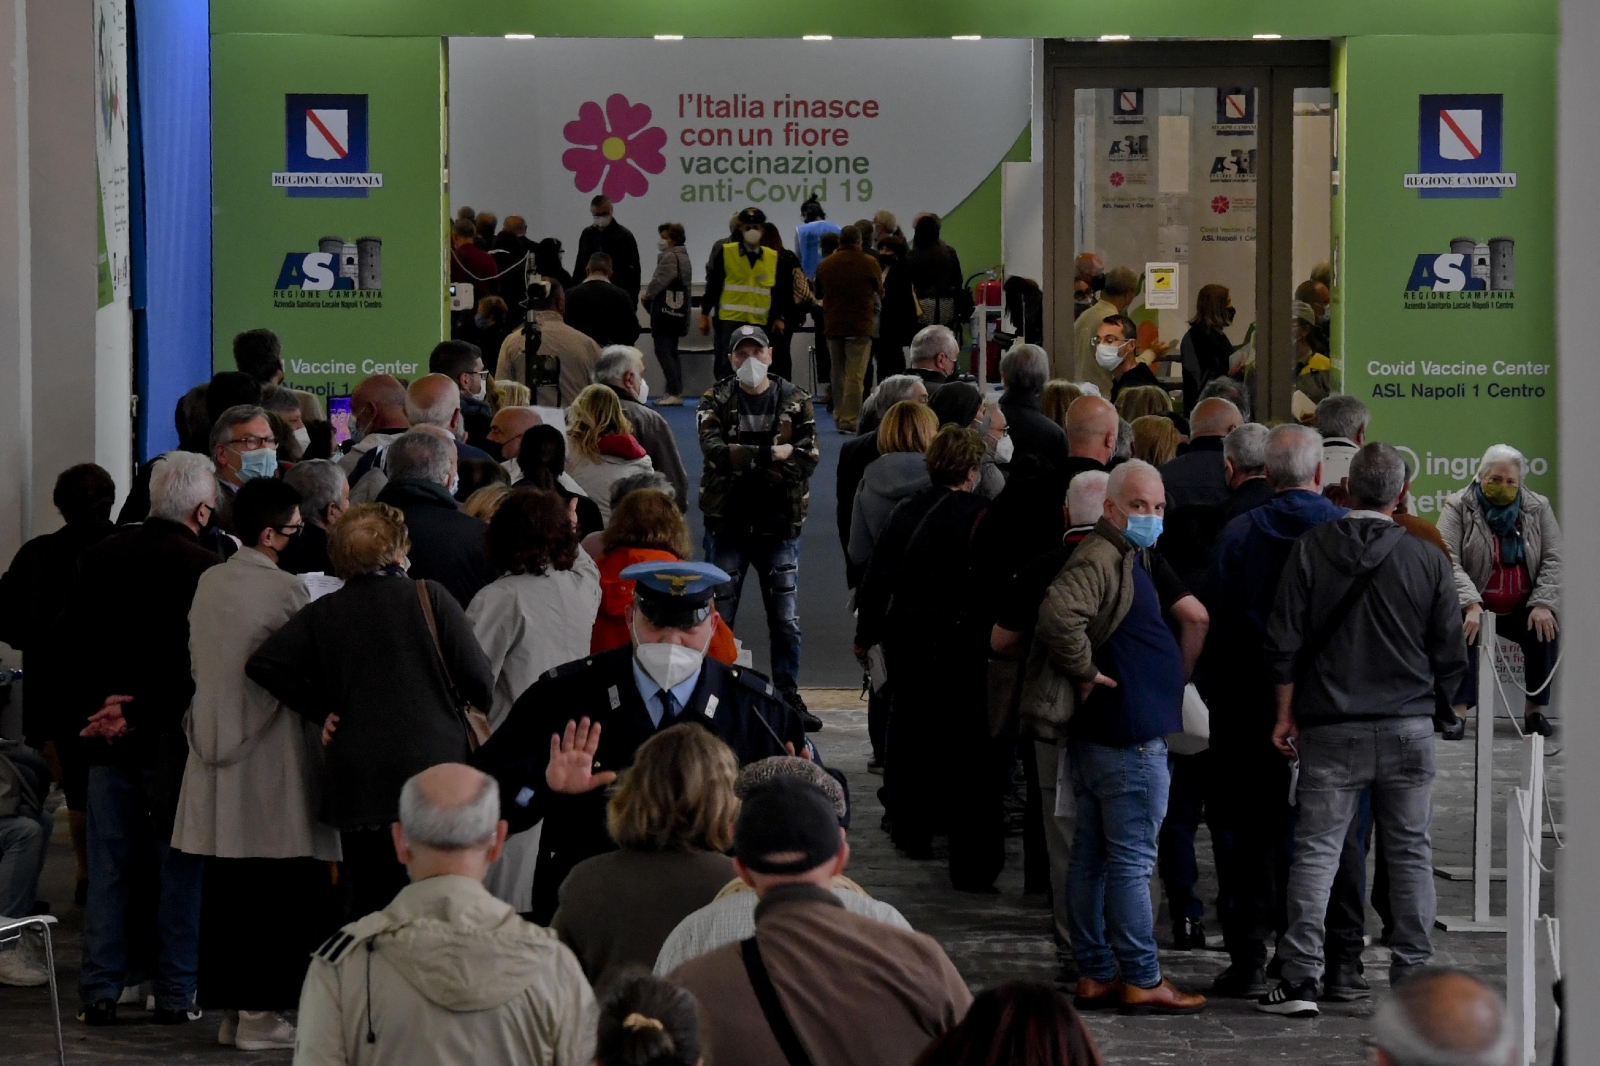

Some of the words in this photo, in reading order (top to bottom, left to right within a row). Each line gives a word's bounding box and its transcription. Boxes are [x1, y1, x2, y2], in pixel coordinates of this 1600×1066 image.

[773, 94, 879, 118] rinasce
[680, 128, 733, 146] con
[738, 128, 773, 146] un
[783, 122, 849, 146] fiore
[680, 150, 870, 174] vaccinazione
[274, 175, 323, 185] REGIONE
[325, 175, 380, 185] CAMPANIA
[1406, 175, 1453, 186] REGIONE
[1457, 175, 1514, 185] CAMPANIA
[680, 177, 827, 203] anti-Covid
[840, 178, 874, 202] 19
[275, 252, 354, 290] ASL
[1405, 253, 1486, 292] ASL
[273, 290, 320, 299] REGIONE
[328, 290, 383, 299] CAMPANIA
[1403, 291, 1451, 300] REGIONE
[1459, 291, 1515, 299] CAMPANIA
[274, 300, 296, 308] Azienda
[322, 300, 340, 308] Locale
[341, 300, 358, 309] Napoli
[364, 300, 382, 308] Centro
[1404, 301, 1426, 309] Azienda
[1427, 301, 1452, 309] Sanitaria
[1453, 301, 1471, 309] Locale
[1472, 301, 1490, 310] Napoli
[1495, 301, 1514, 309] Centro
[290, 358, 357, 374] Vaccine
[361, 358, 419, 374] Center
[1367, 360, 1416, 376] Covid
[1420, 360, 1487, 376] Vaccine
[1492, 360, 1550, 376] Center
[341, 382, 349, 396] 1
[1371, 382, 1406, 398] ASL
[1411, 382, 1465, 400] Napoli
[1472, 383, 1479, 397] 1
[1487, 382, 1546, 398] Centro
